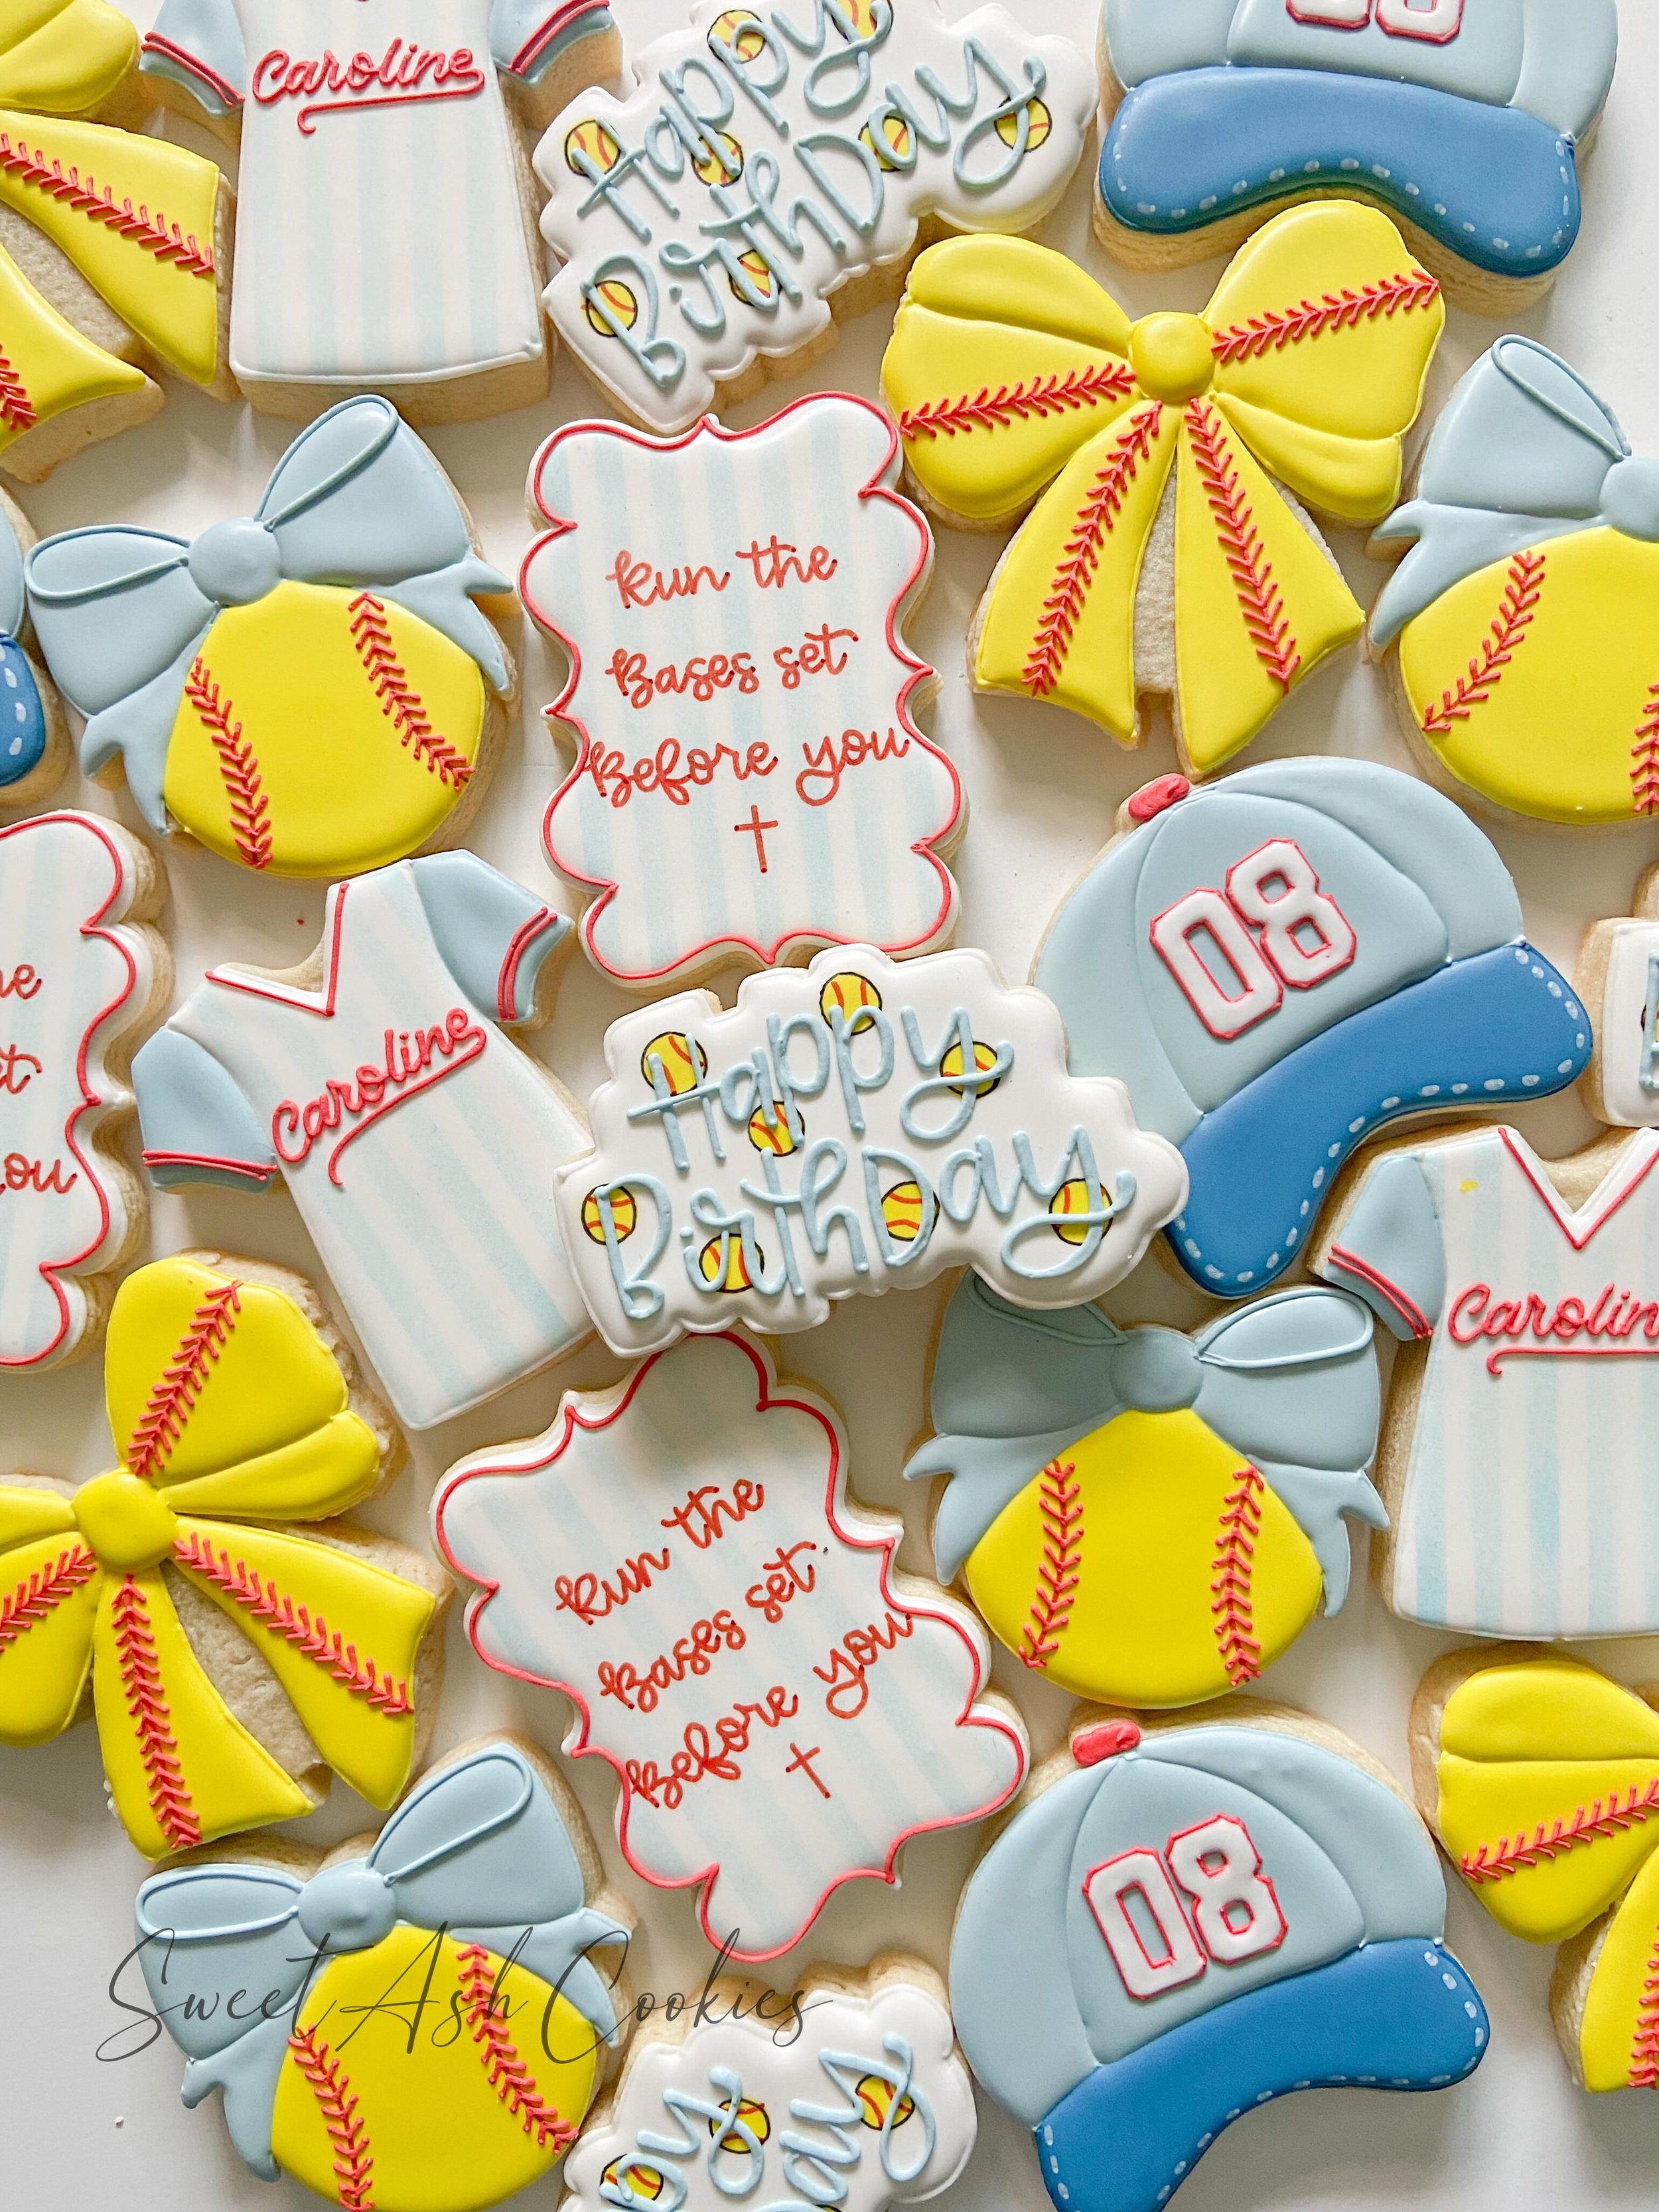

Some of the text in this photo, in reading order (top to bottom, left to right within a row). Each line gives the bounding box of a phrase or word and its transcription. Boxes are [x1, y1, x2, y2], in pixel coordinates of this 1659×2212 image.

[252, 37, 486, 135] Caroline
[577, 0, 893, 244] Happy
[607, 535, 837, 609] Run the
[605, 623, 859, 709] Bases set
[585, 727, 910, 808] Before you
[1149, 838, 1356, 1041] 08
[272, 1007, 487, 1186] Caroline
[627, 1004, 1015, 1172] Happy
[0, 1153, 78, 1194] ou
[1448, 1282, 1659, 1375] Carolin
[555, 1479, 764, 1626] Run the
[598, 1541, 817, 1712] Bases set
[626, 1612, 912, 1810] Before you
[1082, 1812, 1288, 2000] 08
